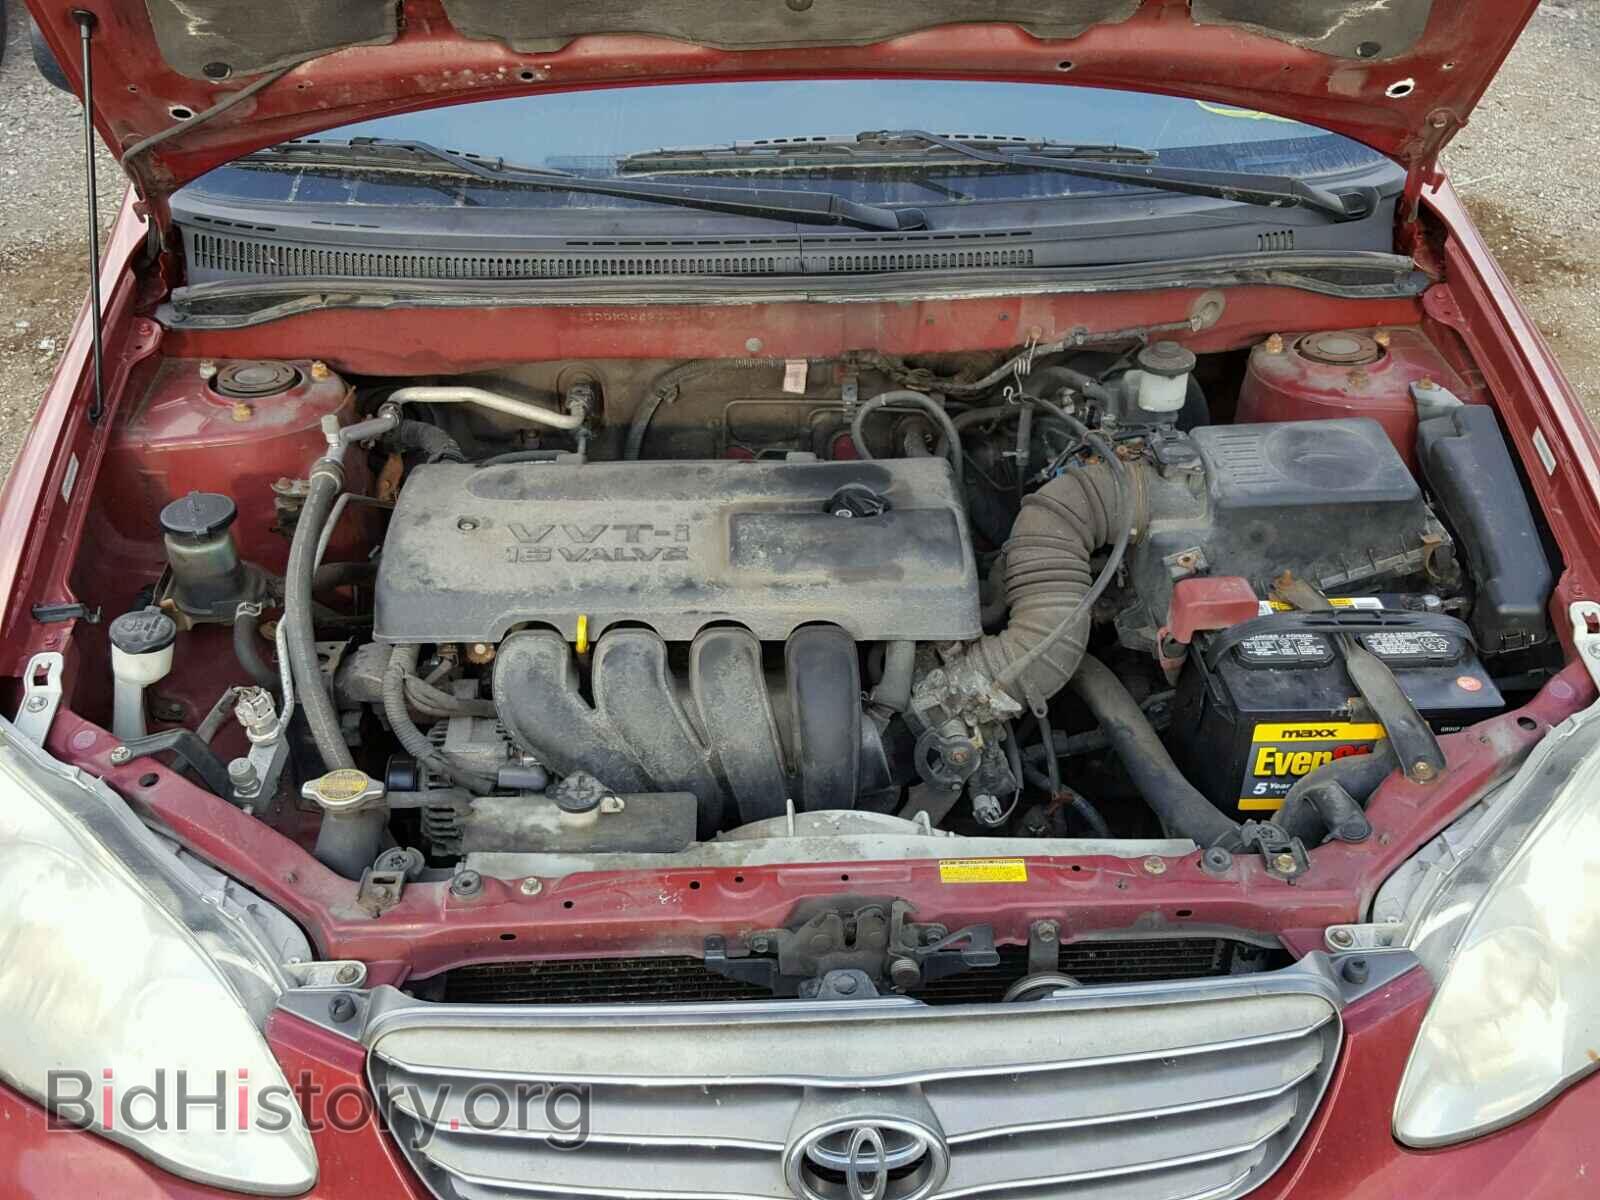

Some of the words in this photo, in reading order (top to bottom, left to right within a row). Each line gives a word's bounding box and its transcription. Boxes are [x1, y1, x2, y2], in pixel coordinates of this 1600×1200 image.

[558, 547, 690, 563] VALVE
[1281, 729, 1339, 739] maxx
[1252, 782, 1269, 795] 5
